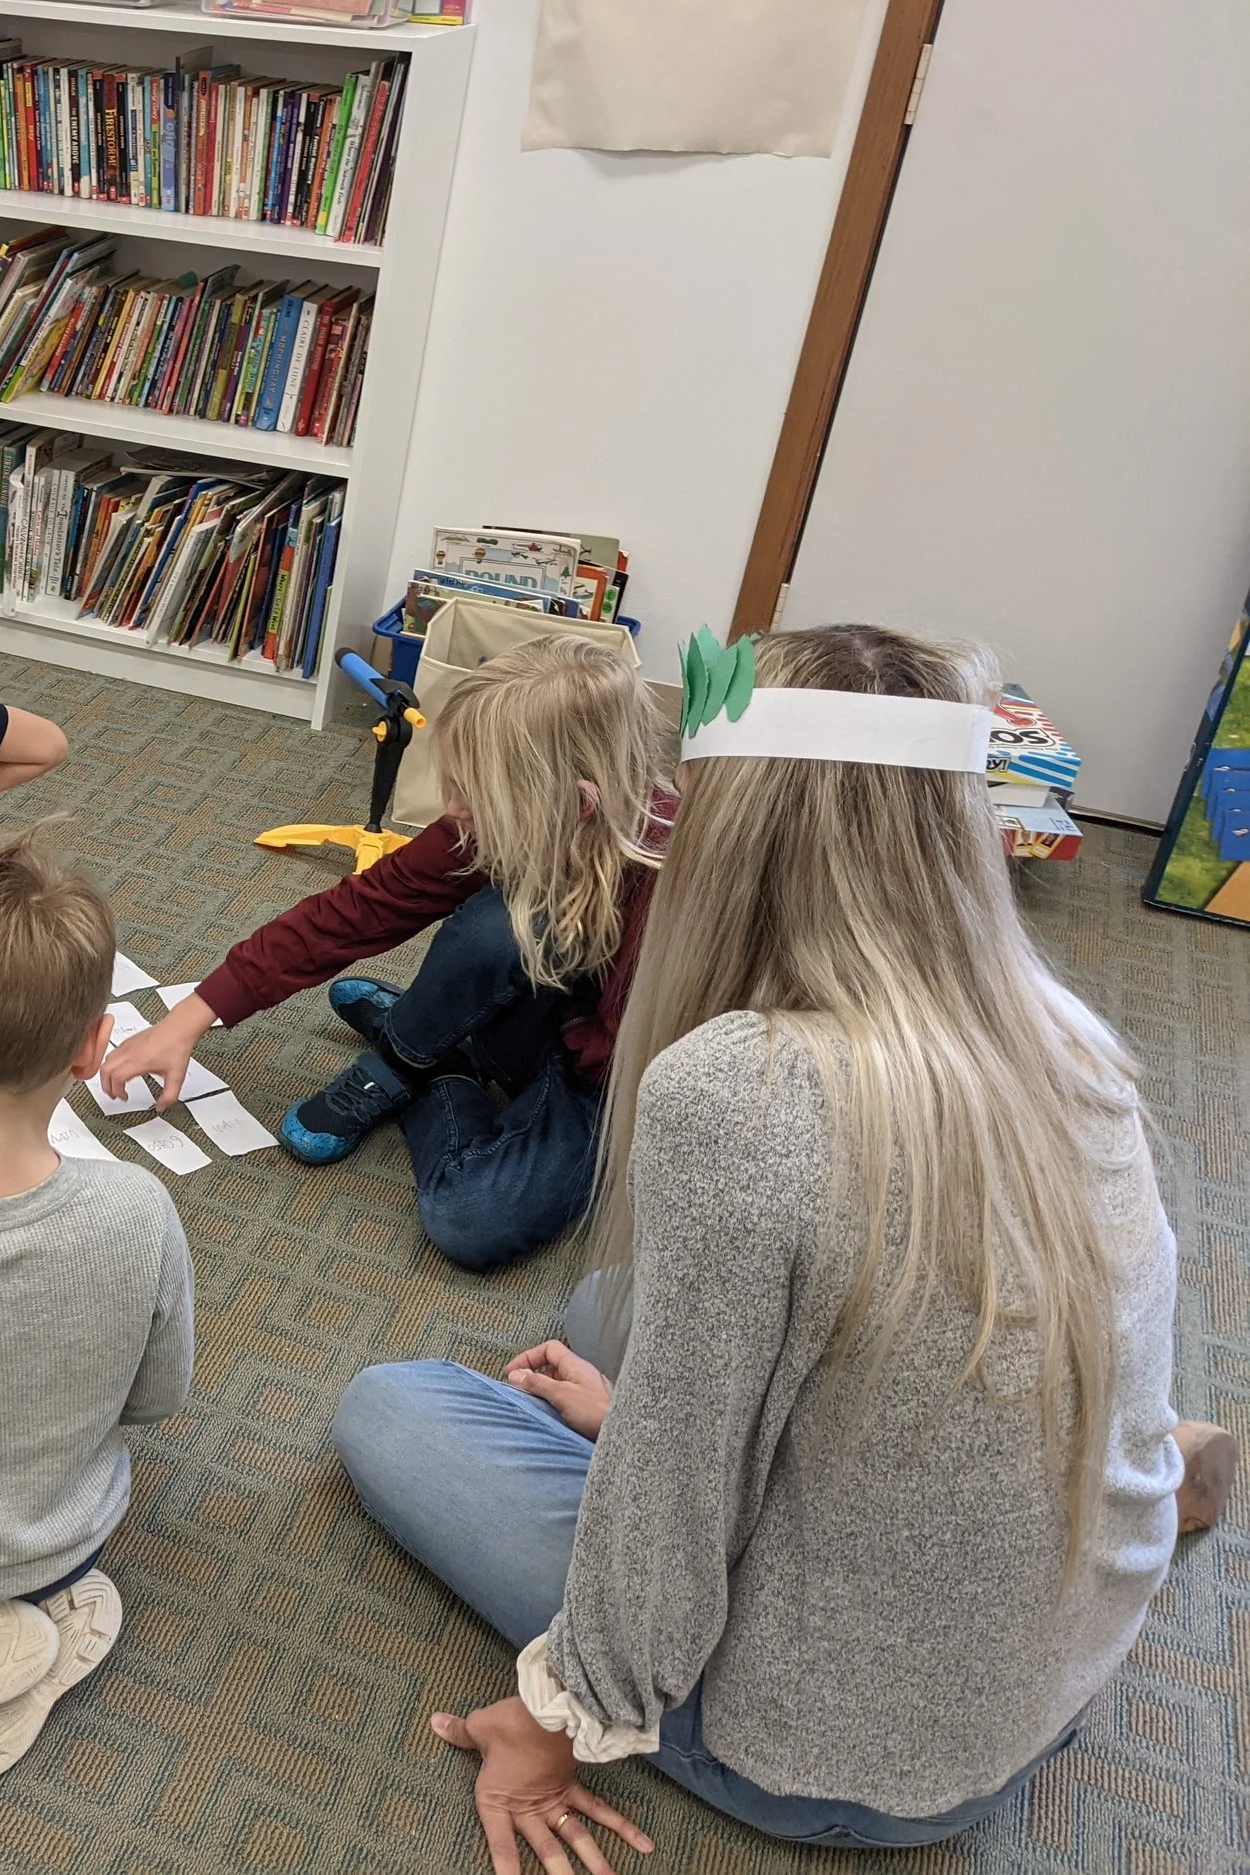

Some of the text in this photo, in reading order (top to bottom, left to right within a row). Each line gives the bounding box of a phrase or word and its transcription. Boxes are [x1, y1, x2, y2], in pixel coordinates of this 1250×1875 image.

[104, 108, 117, 166] FIRESTORM!
[345, 139, 355, 157] Where
[344, 157, 352, 167] the
[267, 334, 288, 393] MOCKINGJAY
[288, 319, 310, 388] CLAIRE DE LUNE
[49, 483, 57, 513] COURAGE
[19, 518, 27, 543] CALVIN
[52, 508, 68, 556] Inquisitor's
[52, 556, 61, 572] Tale
